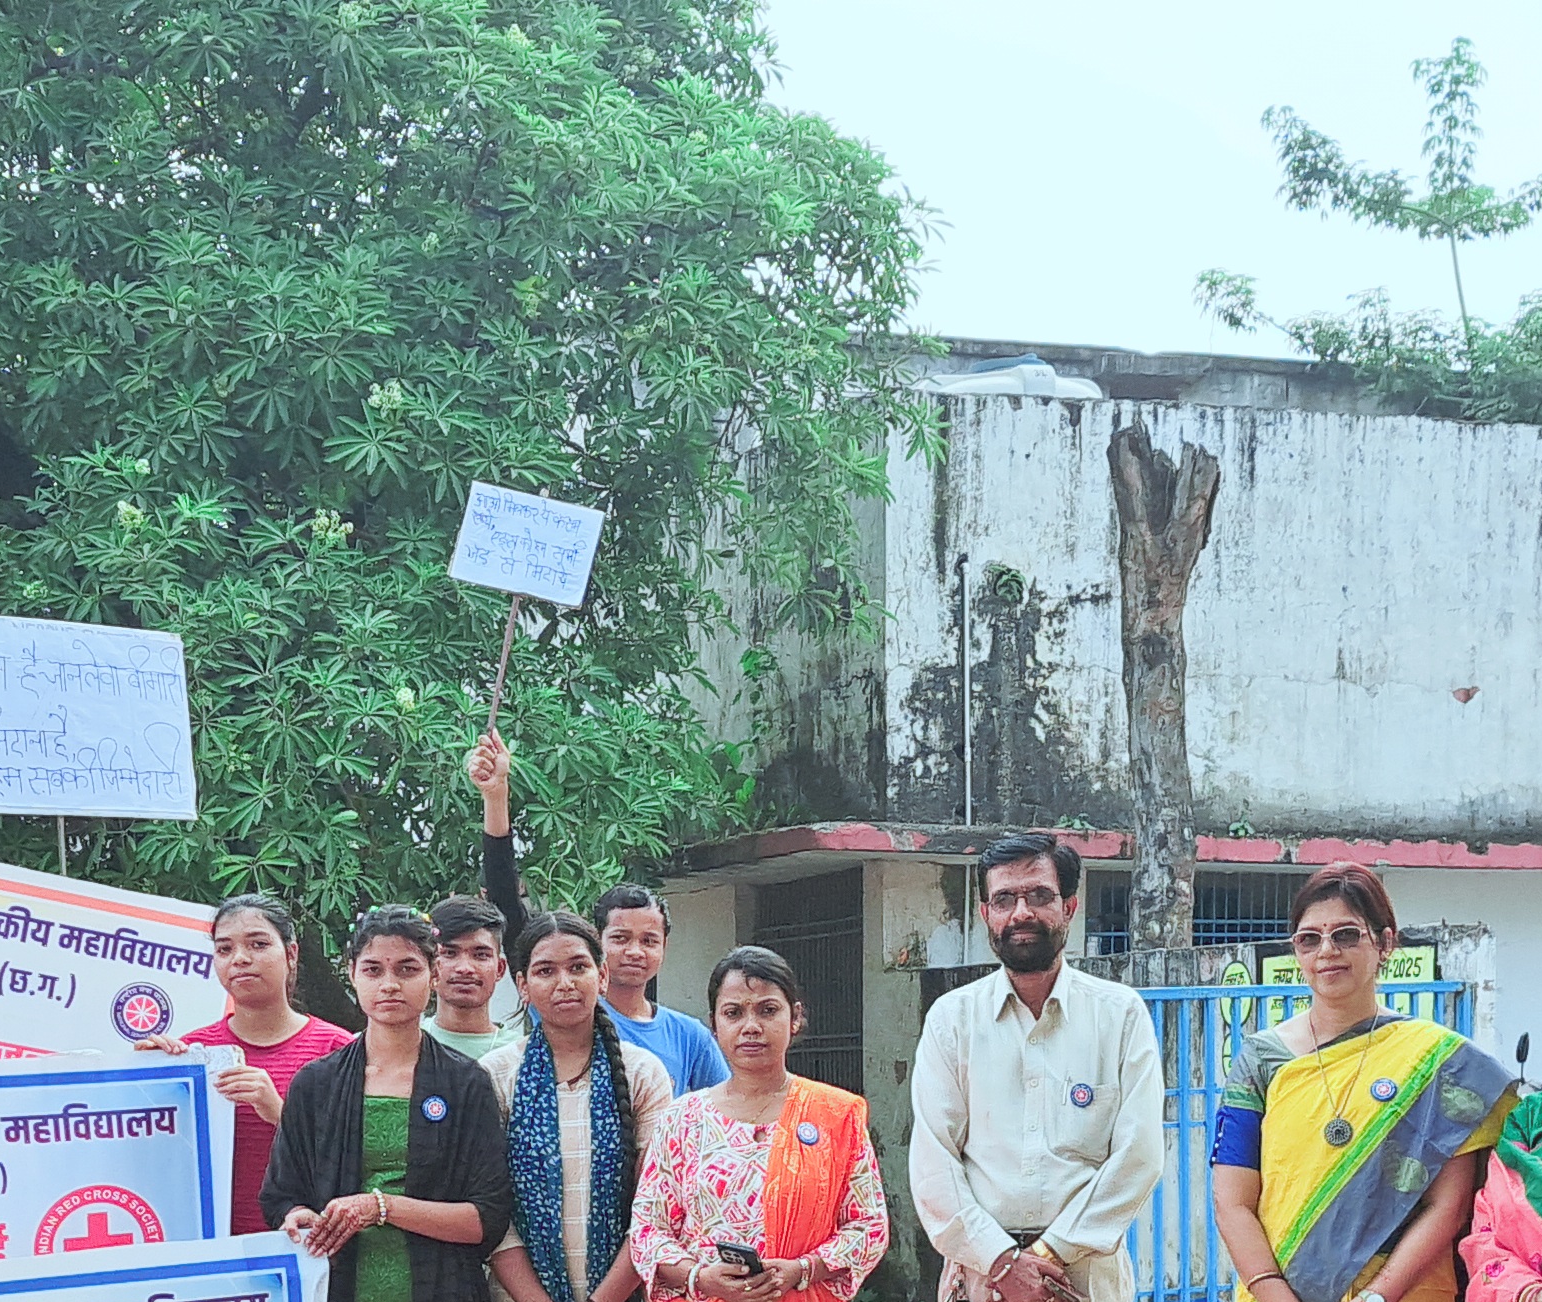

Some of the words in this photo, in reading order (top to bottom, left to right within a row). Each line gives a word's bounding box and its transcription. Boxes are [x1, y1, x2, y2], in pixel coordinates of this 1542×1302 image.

[59, 927, 214, 980] महाविद्यालय
[0, 1102, 178, 1145] महाविद्यालय
[38, 1215, 60, 1255] NDIAN
[55, 1194, 81, 1217] RED
[83, 1189, 129, 1204] CROSS
